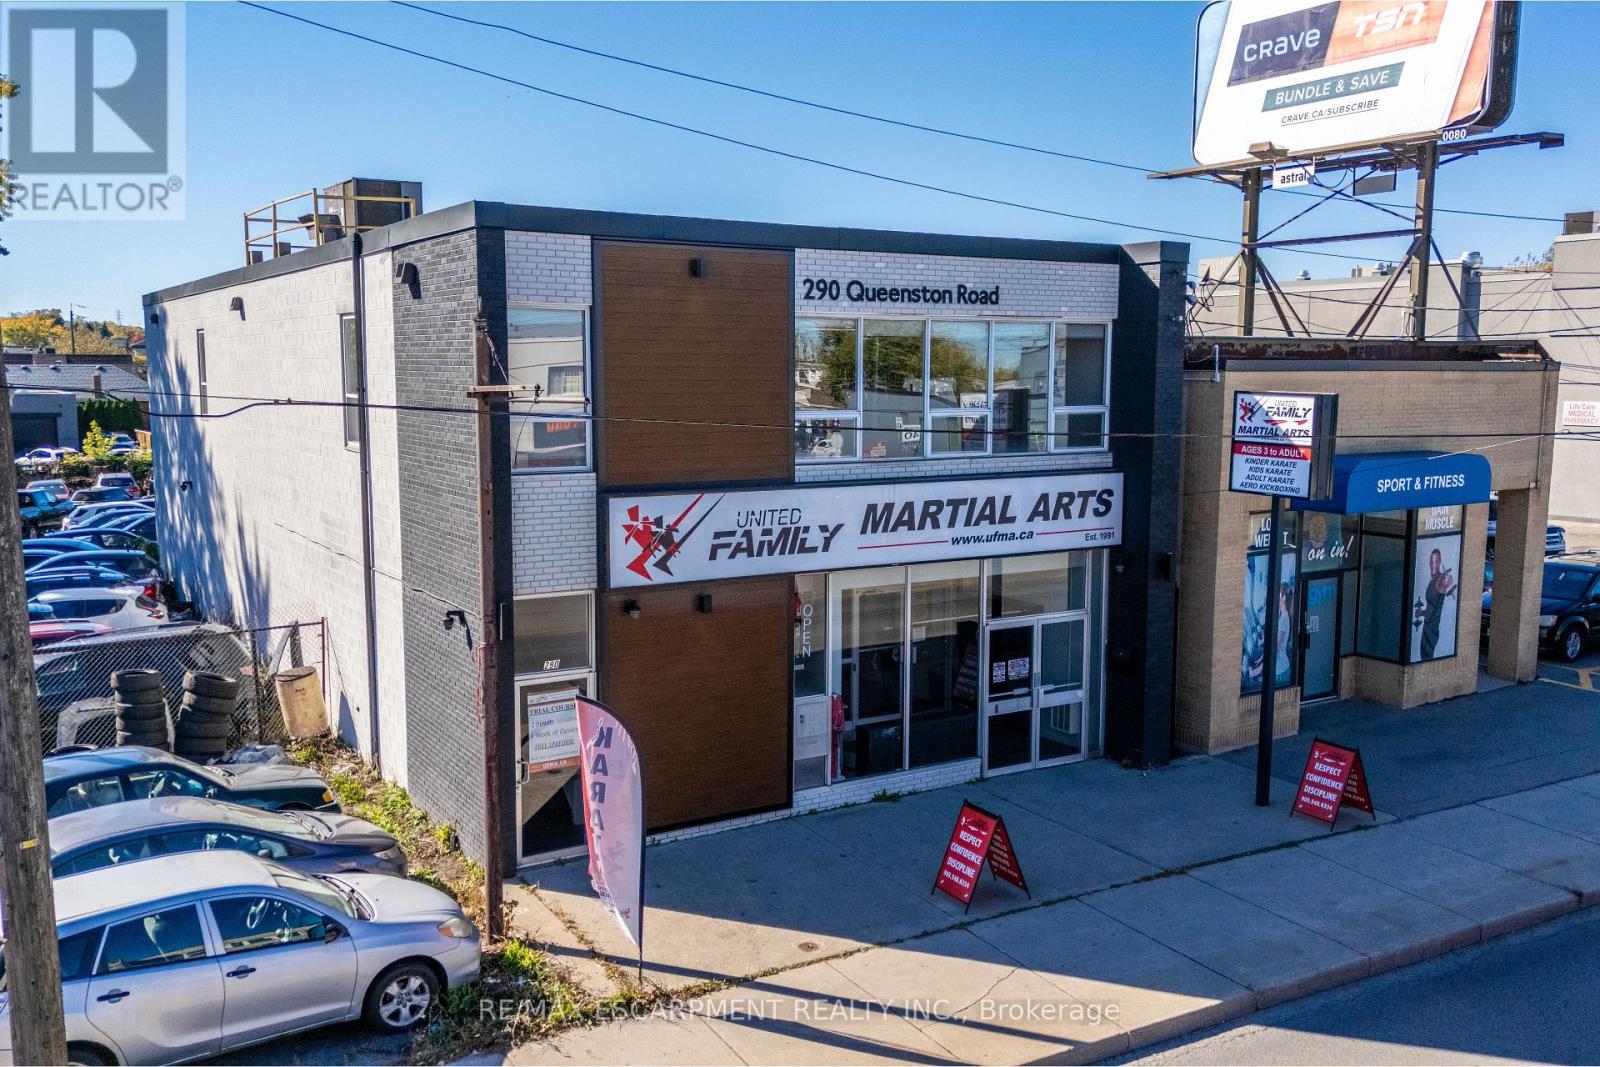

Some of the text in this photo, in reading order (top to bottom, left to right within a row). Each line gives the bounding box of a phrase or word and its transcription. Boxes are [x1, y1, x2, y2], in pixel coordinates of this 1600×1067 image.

[1275, 70, 1390, 105] BUNDLE & SAVE
[1281, 99, 1379, 124] CRAVE.CA/SUBSCRIBE
[1442, 128, 1467, 141] 0080
[1280, 170, 1307, 184] astral
[803, 278, 999, 305] 290 Queenston Road
[1266, 406, 1312, 418] FAMILY
[1275, 400, 1297, 408] UNITED
[1238, 425, 1310, 438] MARTIAL ARTS
[1241, 445, 1304, 458] AGES 3 to ADULT
[1245, 457, 1297, 469] KINDER KARATE
[1245, 474, 1295, 485] ADULT KARATE
[1265, 468, 1292, 476] KARATE
[1240, 481, 1300, 494] AERO KICKBOXING
[1377, 474, 1465, 493] SPORT & FITNESS
[736, 508, 802, 528] UNITED
[860, 488, 1115, 535] MARTIAL ARTS
[1425, 517, 1454, 530] MUSCLE
[708, 523, 845, 561] FAMILY
[950, 530, 1115, 545] www.ufma.ca Est. 1991
[1308, 535, 1354, 560] on in!
[802, 604, 813, 658] OPEN
[1315, 763, 1342, 776] RESPECT
[1306, 773, 1344, 791] CONFIDENCE
[1304, 785, 1337, 802] DISCIPLINE
[960, 831, 982, 848] RESPECT
[951, 843, 982, 864] CONFIDENCE
[947, 857, 975, 877] DISCIPLINE
